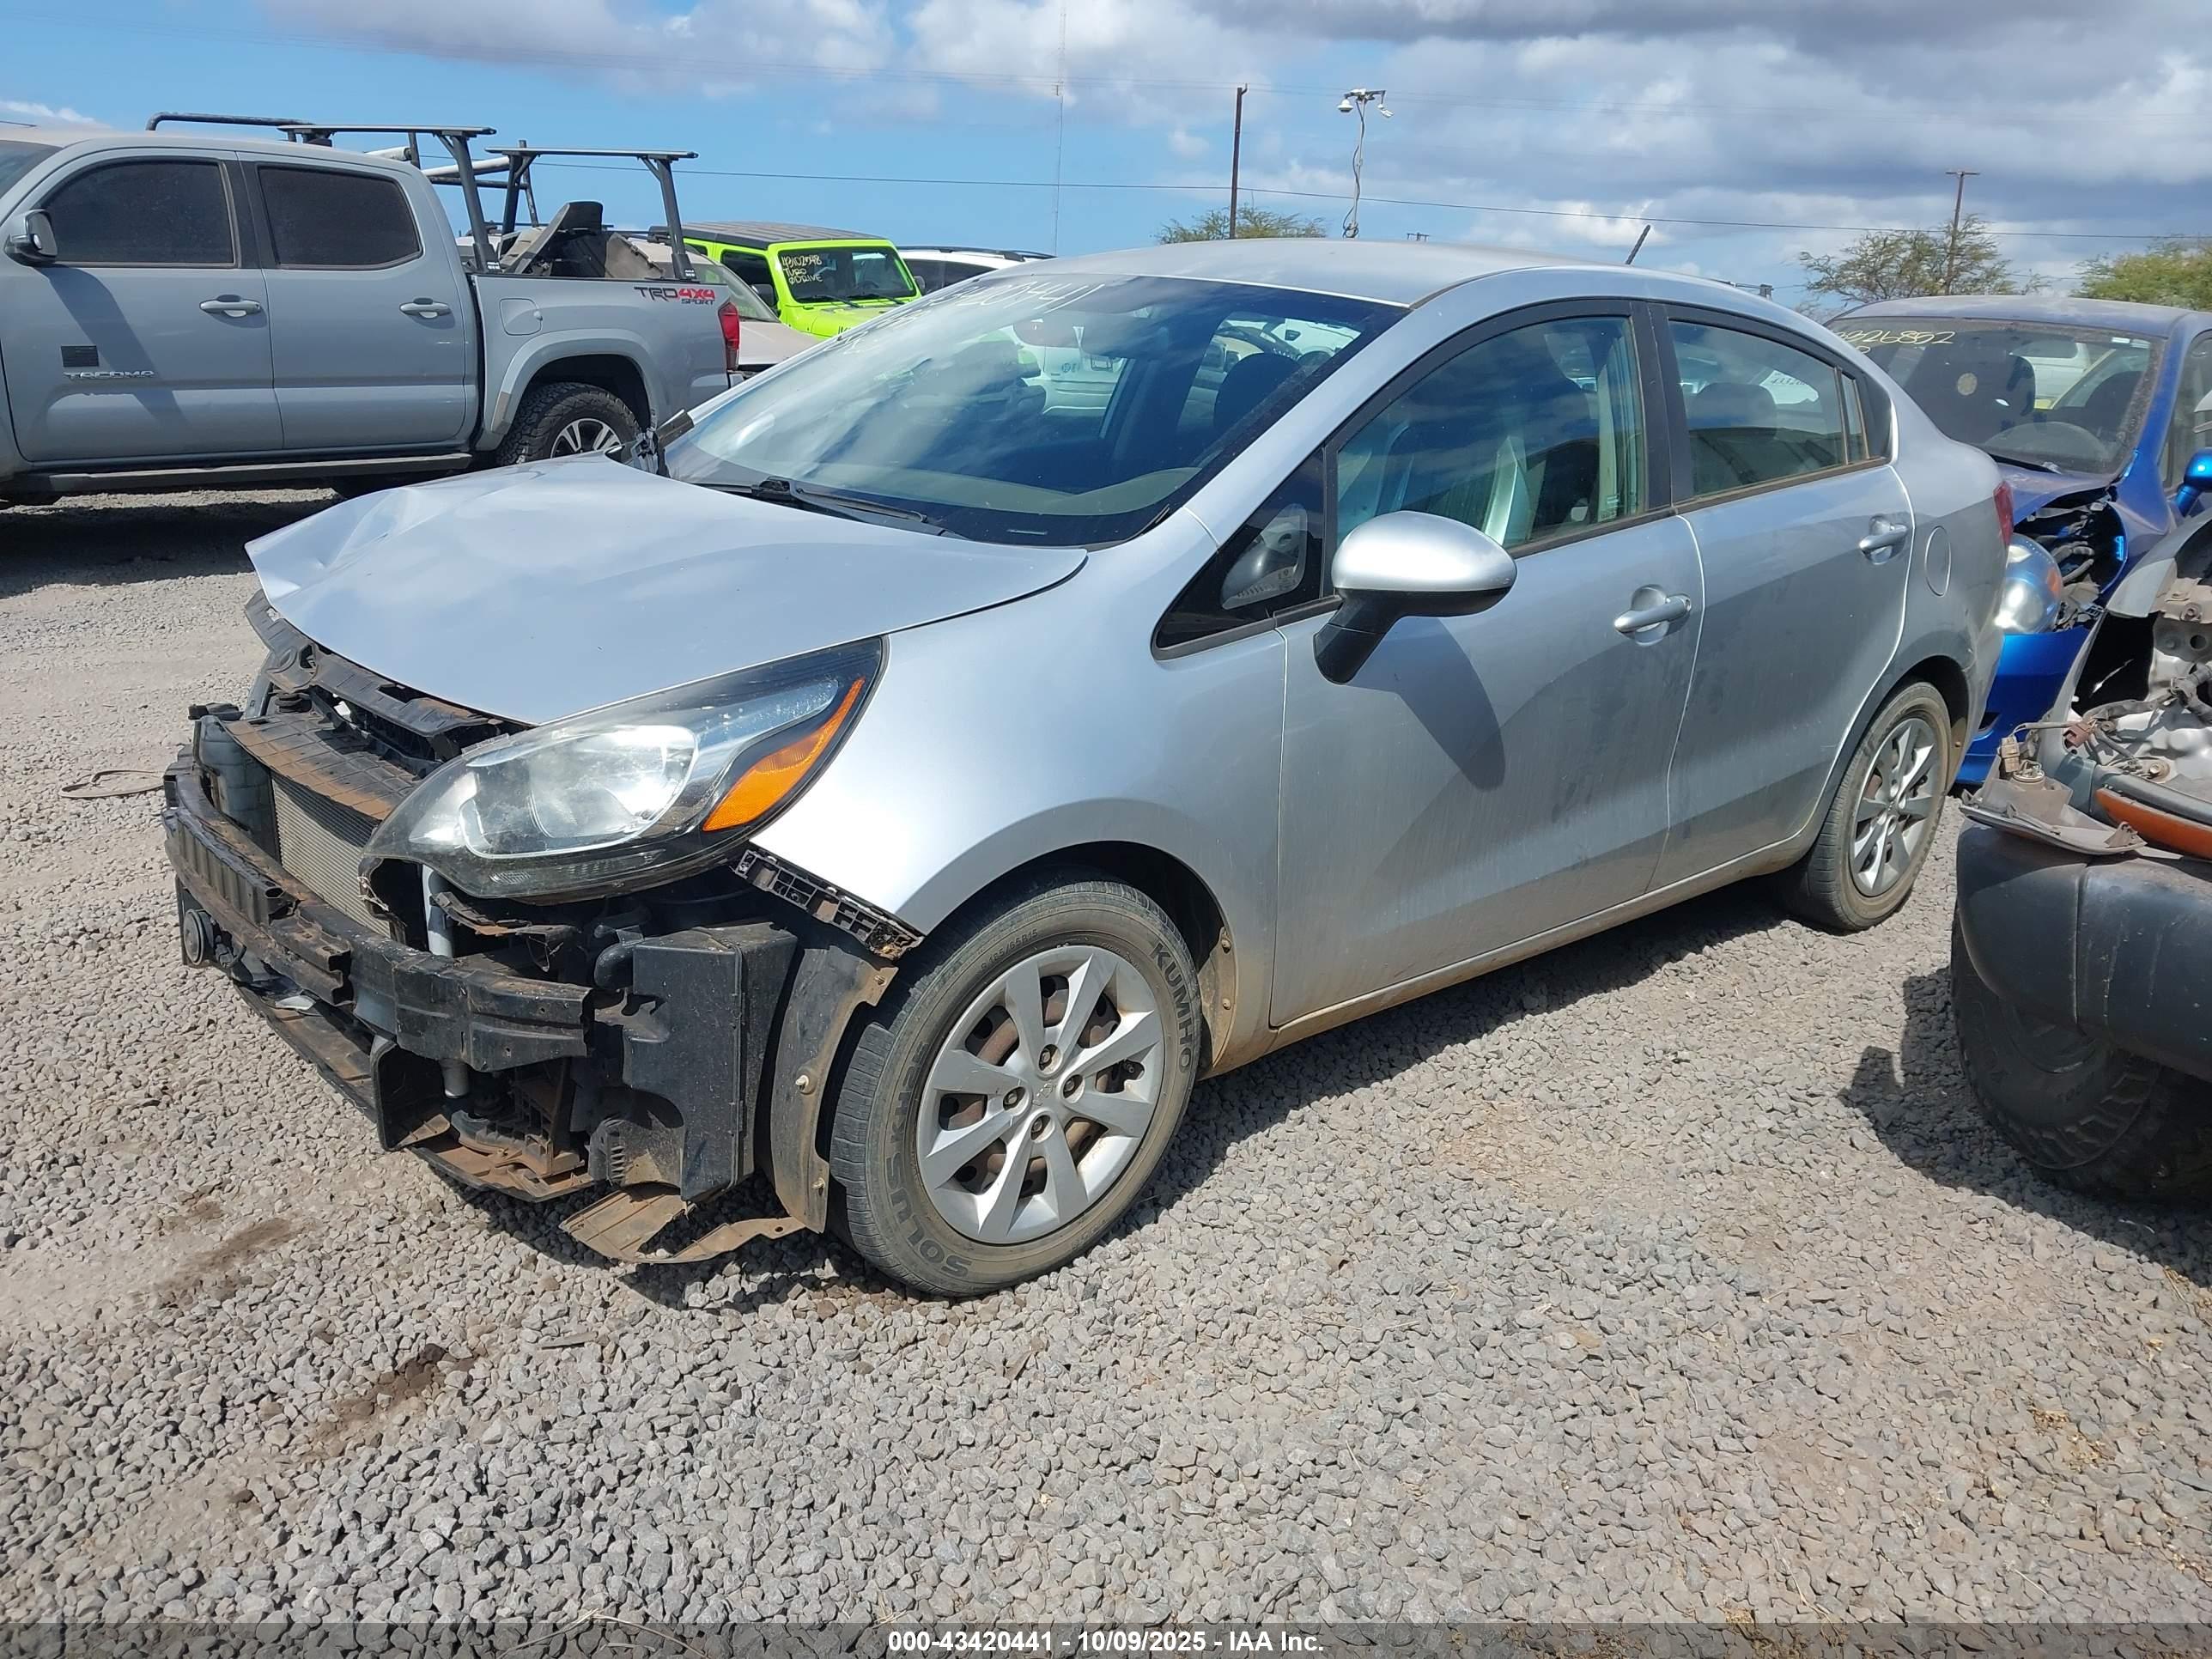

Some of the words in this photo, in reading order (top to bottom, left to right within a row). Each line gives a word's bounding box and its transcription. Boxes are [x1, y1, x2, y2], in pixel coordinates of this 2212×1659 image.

[634, 286, 678, 302] TRD
[63, 369, 155, 381] TACOMA
[1150, 942, 1193, 1072] KUMHO
[886, 1152, 972, 1278] SOLUS
